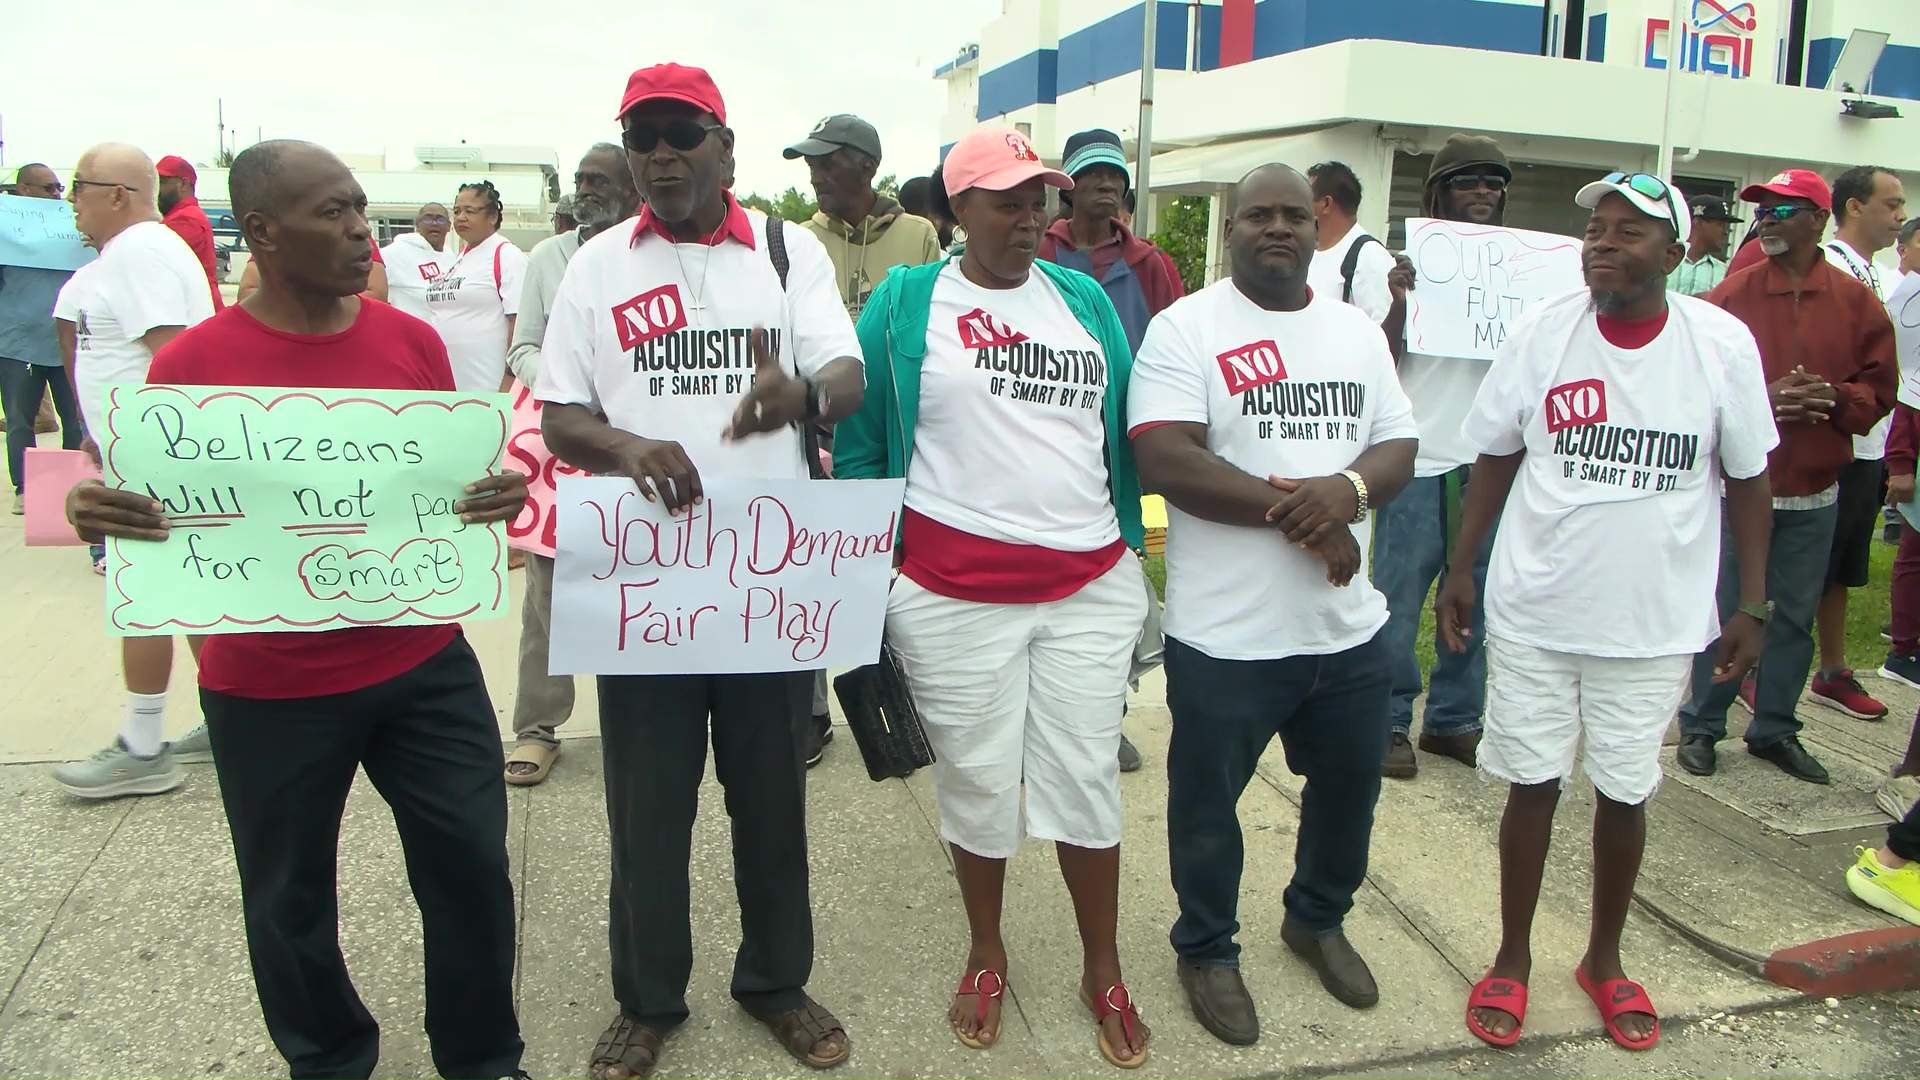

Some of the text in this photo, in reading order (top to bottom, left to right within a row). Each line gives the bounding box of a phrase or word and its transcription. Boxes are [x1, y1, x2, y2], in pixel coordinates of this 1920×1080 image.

[1418, 232, 1510, 288] OUR
[622, 293, 678, 342] NO
[649, 376, 665, 397] OF
[671, 375, 718, 396] SMART
[725, 374, 743, 394] BY
[1226, 346, 1280, 387] NO
[990, 376, 1006, 397] OF
[1011, 380, 1056, 405] SMART
[1060, 388, 1078, 408] BY
[1242, 381, 1366, 419] ACQUISITION
[1552, 386, 1600, 426] NO
[141, 403, 424, 464] Belizeans
[1258, 420, 1274, 440] OF
[1280, 422, 1320, 441] SMART
[1326, 422, 1341, 441] BY
[1553, 423, 1699, 471] ACQUISITION
[1563, 460, 1576, 479] OF
[1580, 462, 1627, 487] SMART
[1631, 470, 1651, 490] BY
[292, 478, 377, 518] not
[183, 533, 457, 587] for Smart
[580, 491, 738, 589] Youth
[747, 495, 896, 577] Demand
[617, 578, 842, 662] Fair Play
